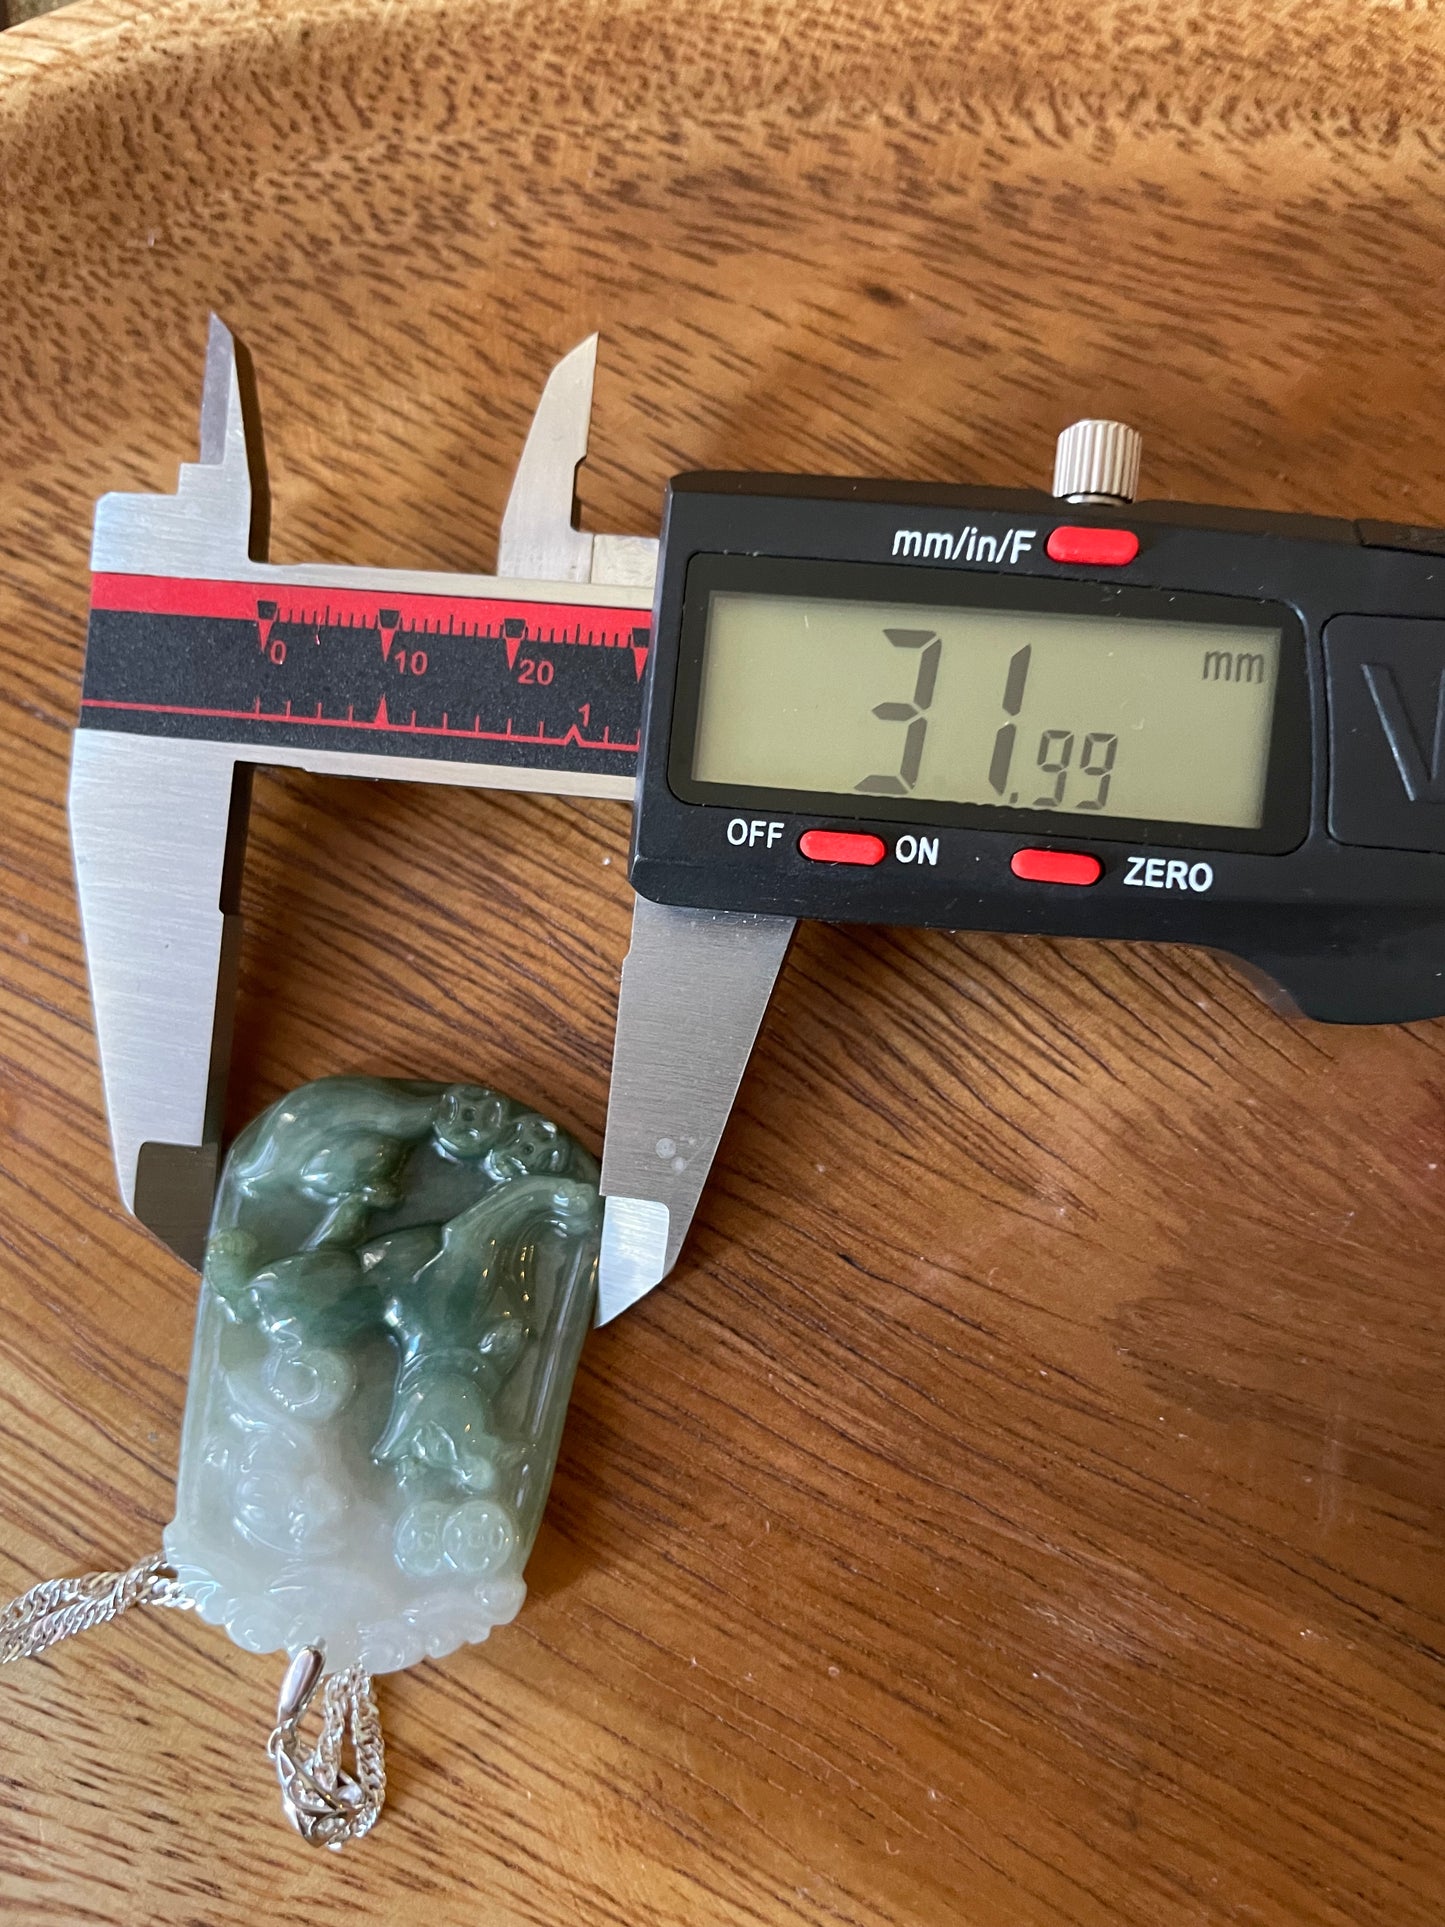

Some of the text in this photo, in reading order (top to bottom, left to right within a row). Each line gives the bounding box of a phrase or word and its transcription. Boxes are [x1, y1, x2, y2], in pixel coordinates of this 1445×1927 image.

[891, 527, 1036, 564] mm/in/F
[268, 639, 555, 686] 0 10 20
[1202, 649, 1265, 684] mm
[577, 703, 592, 727] 1
[853, 628, 1118, 809] 31.99
[726, 817, 785, 850] OFF
[895, 835, 940, 867] ON
[1123, 857, 1214, 893] ZERO
